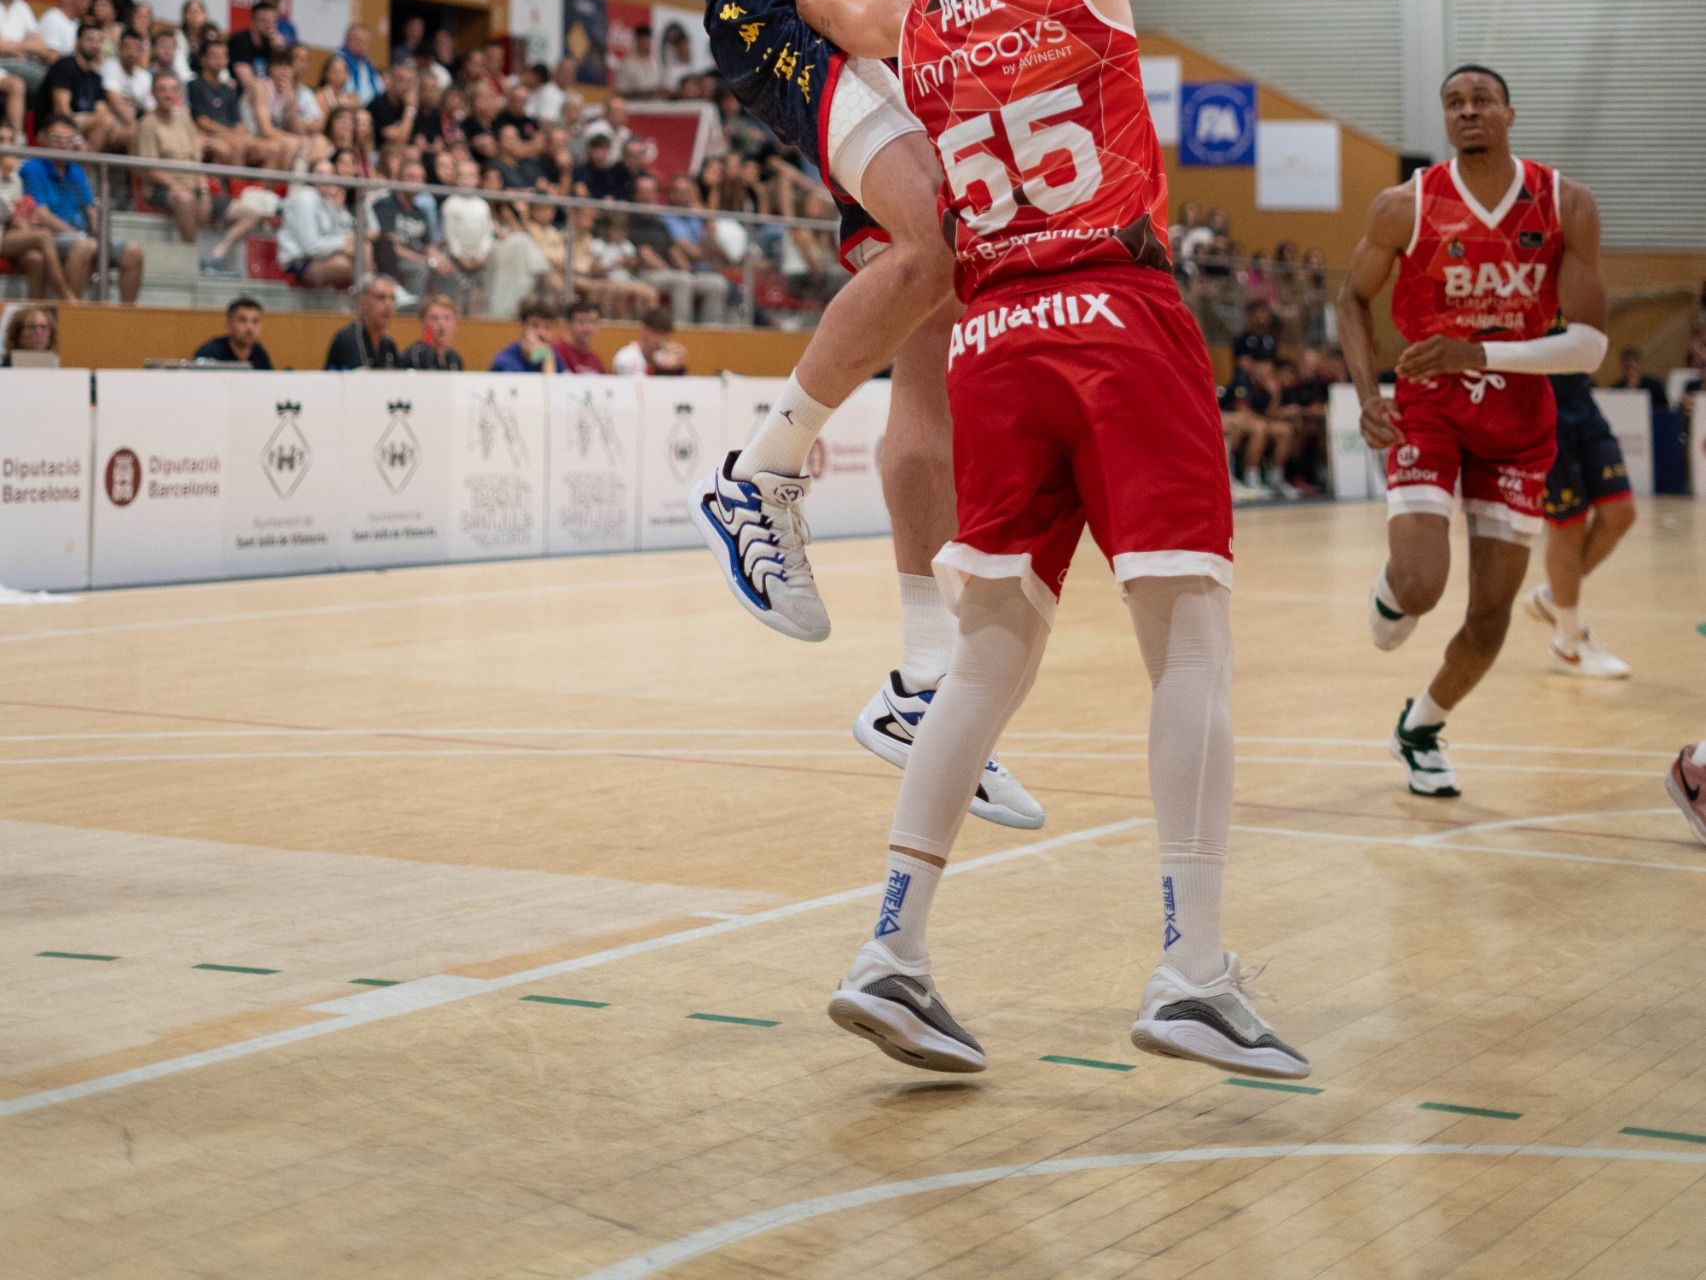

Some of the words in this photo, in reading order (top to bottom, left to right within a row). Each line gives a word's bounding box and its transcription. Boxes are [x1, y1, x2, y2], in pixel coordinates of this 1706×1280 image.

[1002, 64, 1016, 76] by
[1018, 46, 1074, 69] AVINENT
[937, 83, 1104, 236] 55
[1443, 261, 1547, 298] BAXI
[2, 457, 80, 479] Diputació
[150, 454, 220, 476] Diputació
[2, 484, 80, 504] Barcelona
[149, 479, 219, 499] Barcelona
